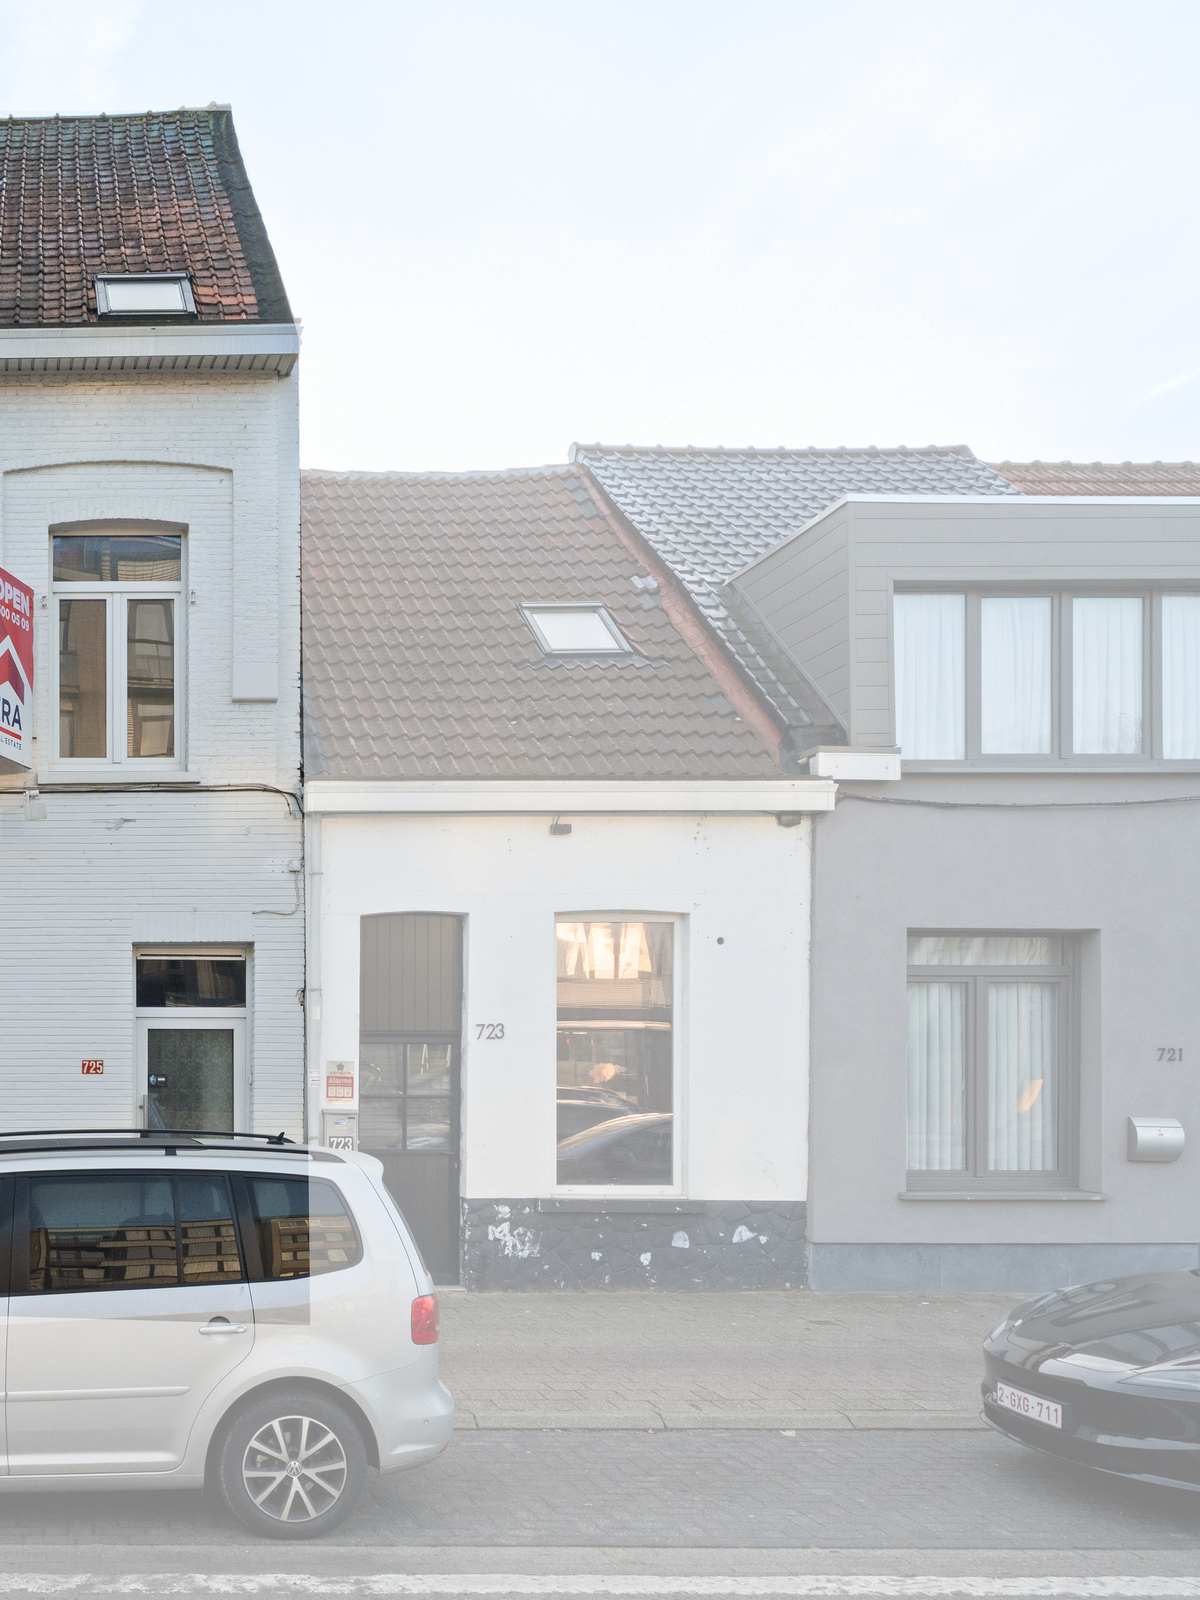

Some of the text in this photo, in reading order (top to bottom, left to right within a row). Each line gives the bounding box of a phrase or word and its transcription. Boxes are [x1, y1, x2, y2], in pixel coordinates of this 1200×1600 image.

[11, 612, 20, 626] 05
[21, 618, 30, 632] 09
[4, 736, 22, 751] ESTATE
[476, 1023, 505, 1040] 723
[1157, 1048, 1183, 1061] 721
[83, 1061, 103, 1074] 725
[330, 1137, 352, 1150] 723
[998, 1387, 1059, 1424] 2-GXG-711
